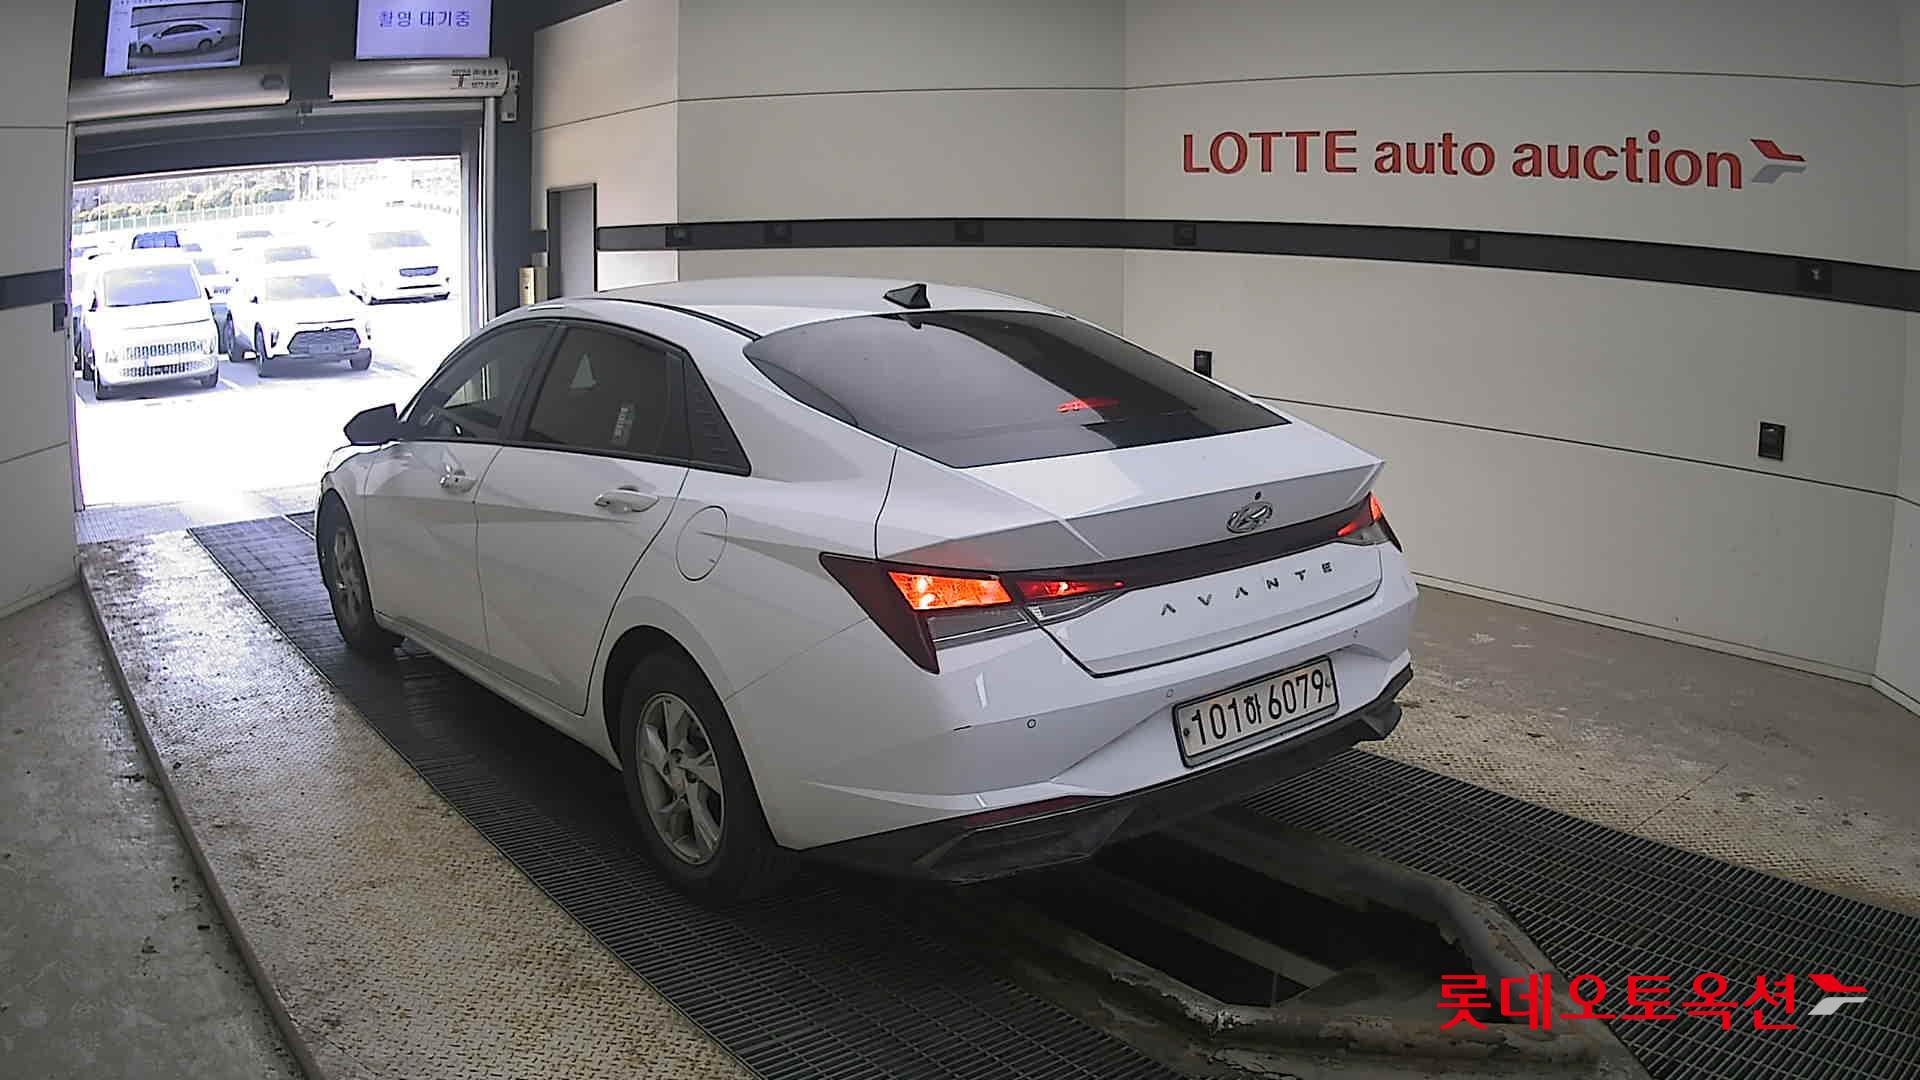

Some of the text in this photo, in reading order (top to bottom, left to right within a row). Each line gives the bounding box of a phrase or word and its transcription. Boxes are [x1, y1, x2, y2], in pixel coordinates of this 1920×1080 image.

[420, 10, 471, 28] 대기중
[1183, 130, 1743, 189] LOTTE auto auction
[1161, 562, 1333, 616] AVANTE
